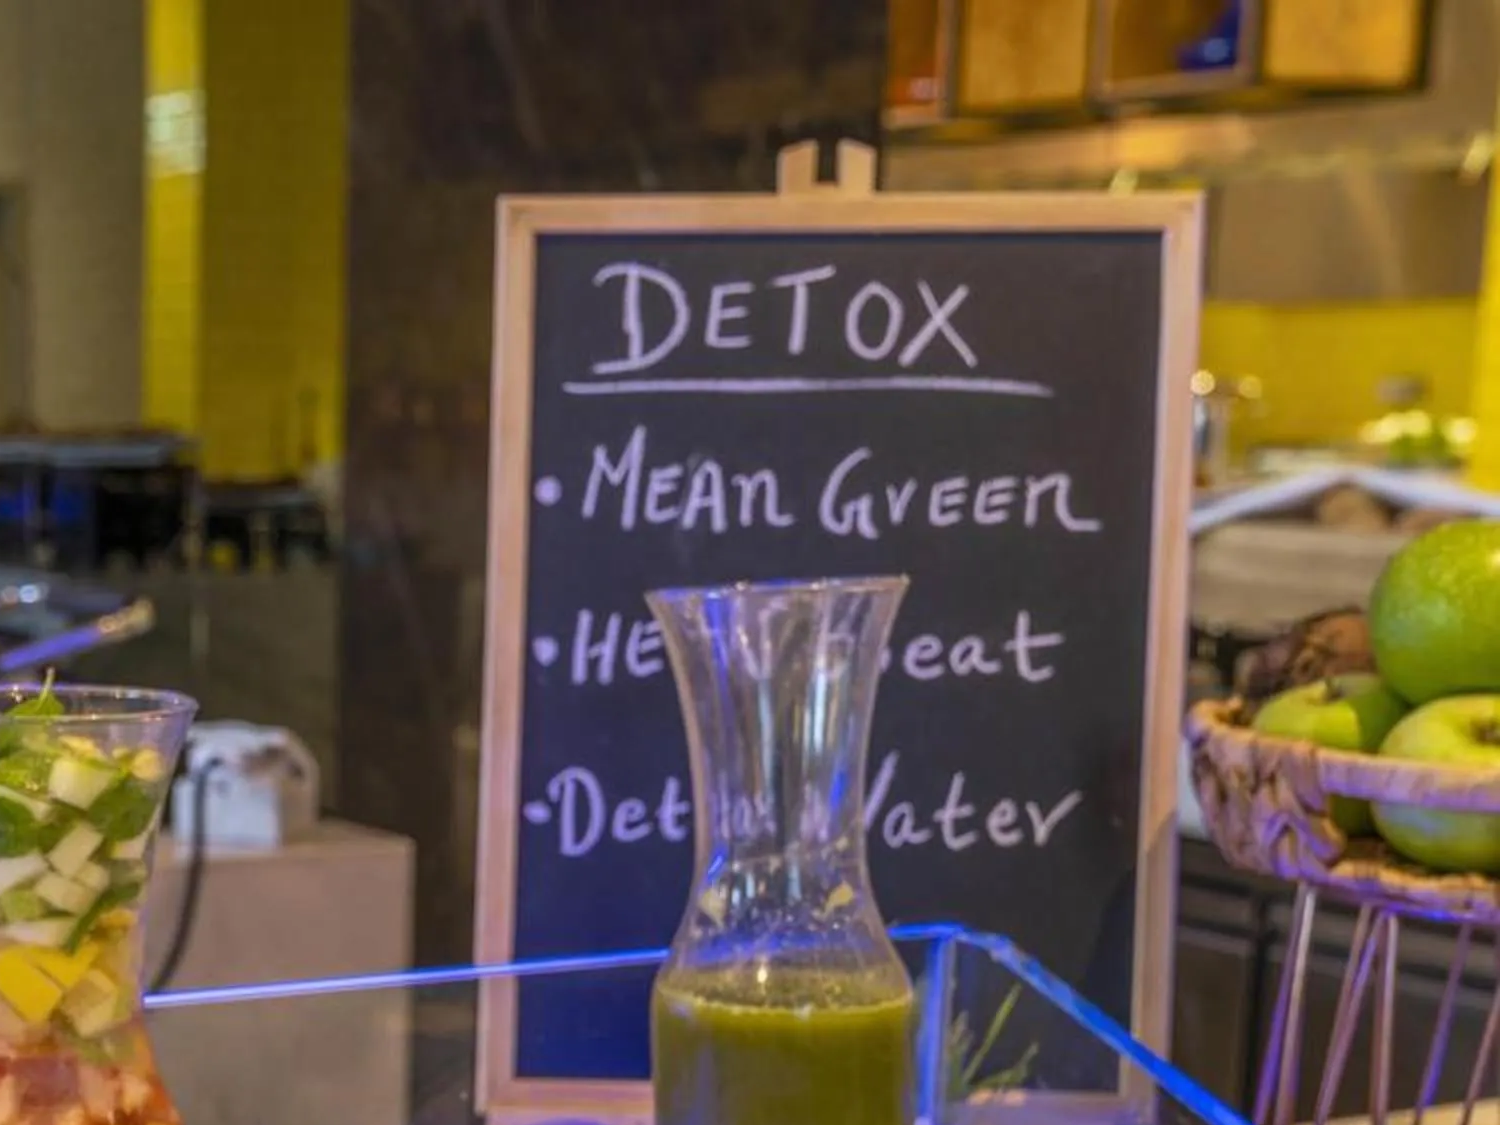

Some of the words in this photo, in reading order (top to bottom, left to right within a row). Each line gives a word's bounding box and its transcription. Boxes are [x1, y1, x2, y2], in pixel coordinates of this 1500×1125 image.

[591, 261, 978, 375] DETOX
[845, 608, 1067, 683] eat
[546, 765, 772, 858] Det
